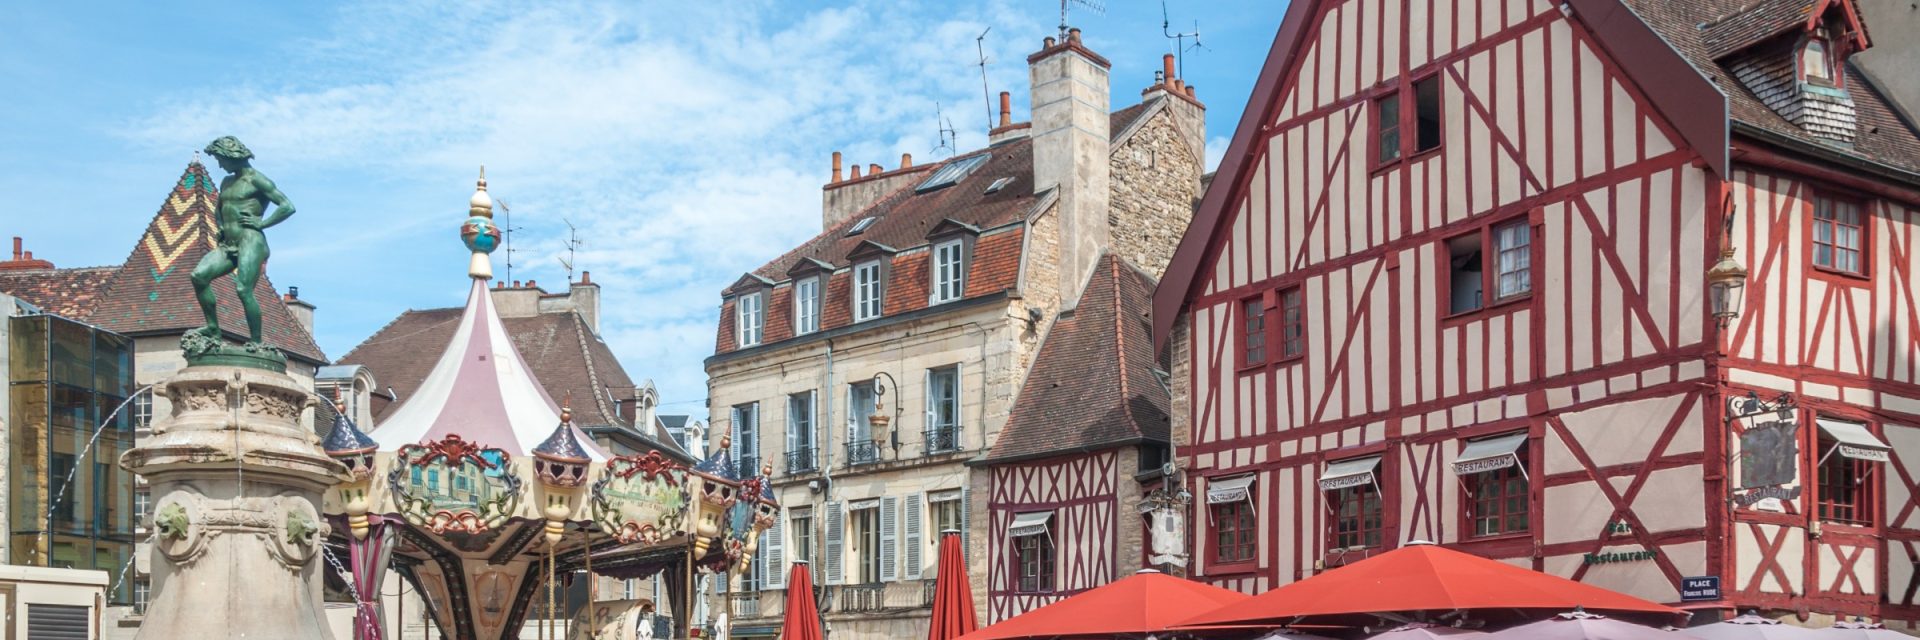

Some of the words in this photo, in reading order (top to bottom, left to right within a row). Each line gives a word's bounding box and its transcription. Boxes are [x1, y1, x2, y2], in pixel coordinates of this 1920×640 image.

[1458, 456, 1511, 473] RESTAURANT
[1323, 474, 1367, 488] RESTAURANT
[1744, 486, 1792, 505] RESTAURANT
[1608, 521, 1632, 534] Bar
[1584, 549, 1657, 565] Restaurant
[1689, 580, 1711, 588] PLACE
